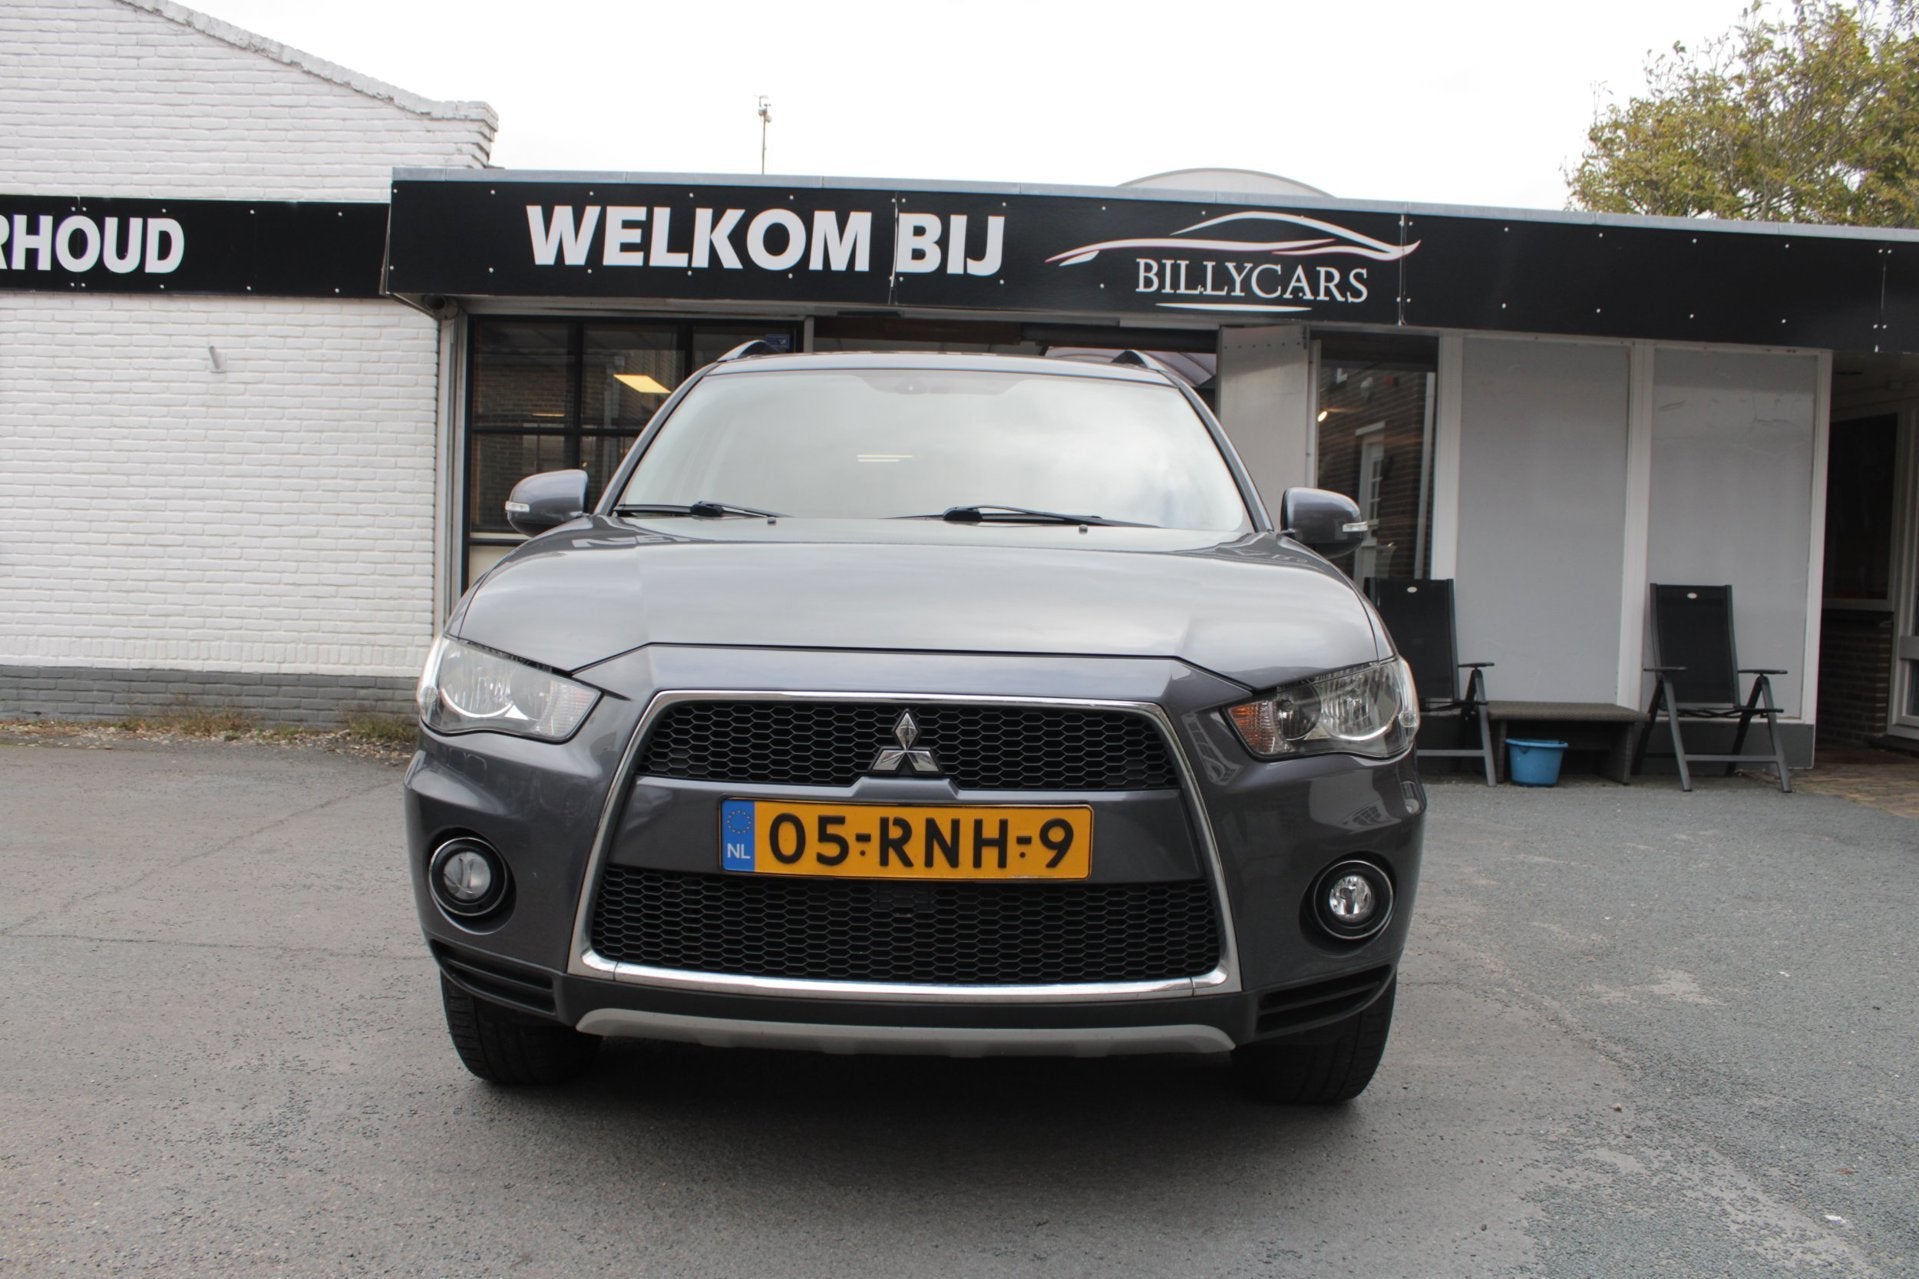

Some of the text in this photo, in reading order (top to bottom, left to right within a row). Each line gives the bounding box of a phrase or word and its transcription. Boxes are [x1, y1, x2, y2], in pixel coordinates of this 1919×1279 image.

[526, 205, 1005, 277] WELKOM BIJ
[1135, 258, 1368, 303] BILLYCARS
[726, 843, 751, 859] NL
[769, 812, 1075, 869] 05-RNH-9
